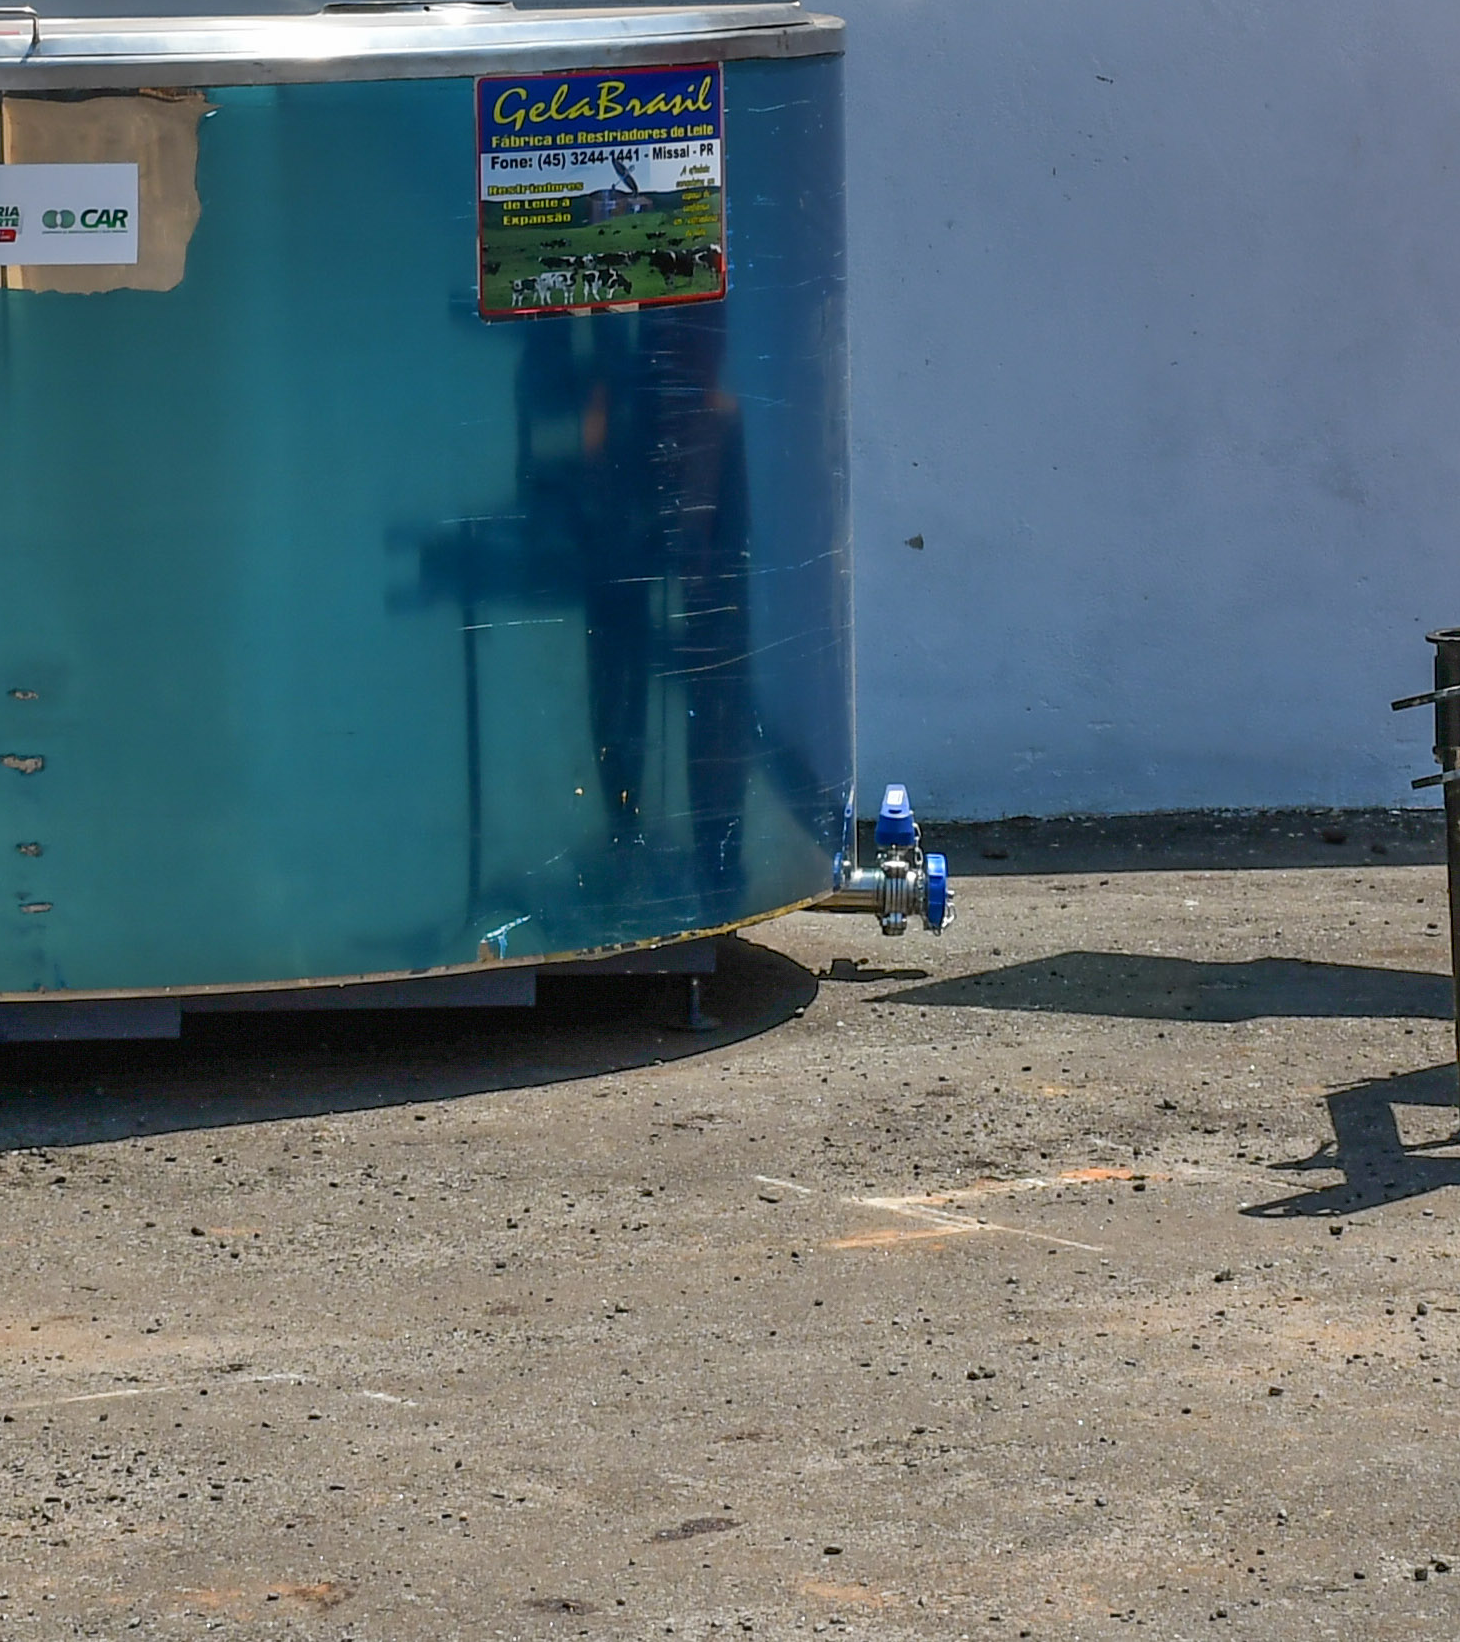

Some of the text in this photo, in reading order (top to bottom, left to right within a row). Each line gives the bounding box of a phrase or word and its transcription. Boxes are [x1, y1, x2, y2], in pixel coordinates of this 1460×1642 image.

[491, 123, 714, 148] Fábrica de Resfriadores de Leite
[491, 156, 533, 170] Fone:
[538, 151, 566, 171] (45)
[570, 148, 640, 166] 3244-1441
[652, 145, 690, 160] Missal
[700, 143, 714, 157] PR
[488, 182, 584, 196] Resfriadores
[503, 200, 521, 210] de
[524, 198, 559, 209] Leite
[80, 209, 128, 228] CAR
[503, 212, 571, 227] Expansão
